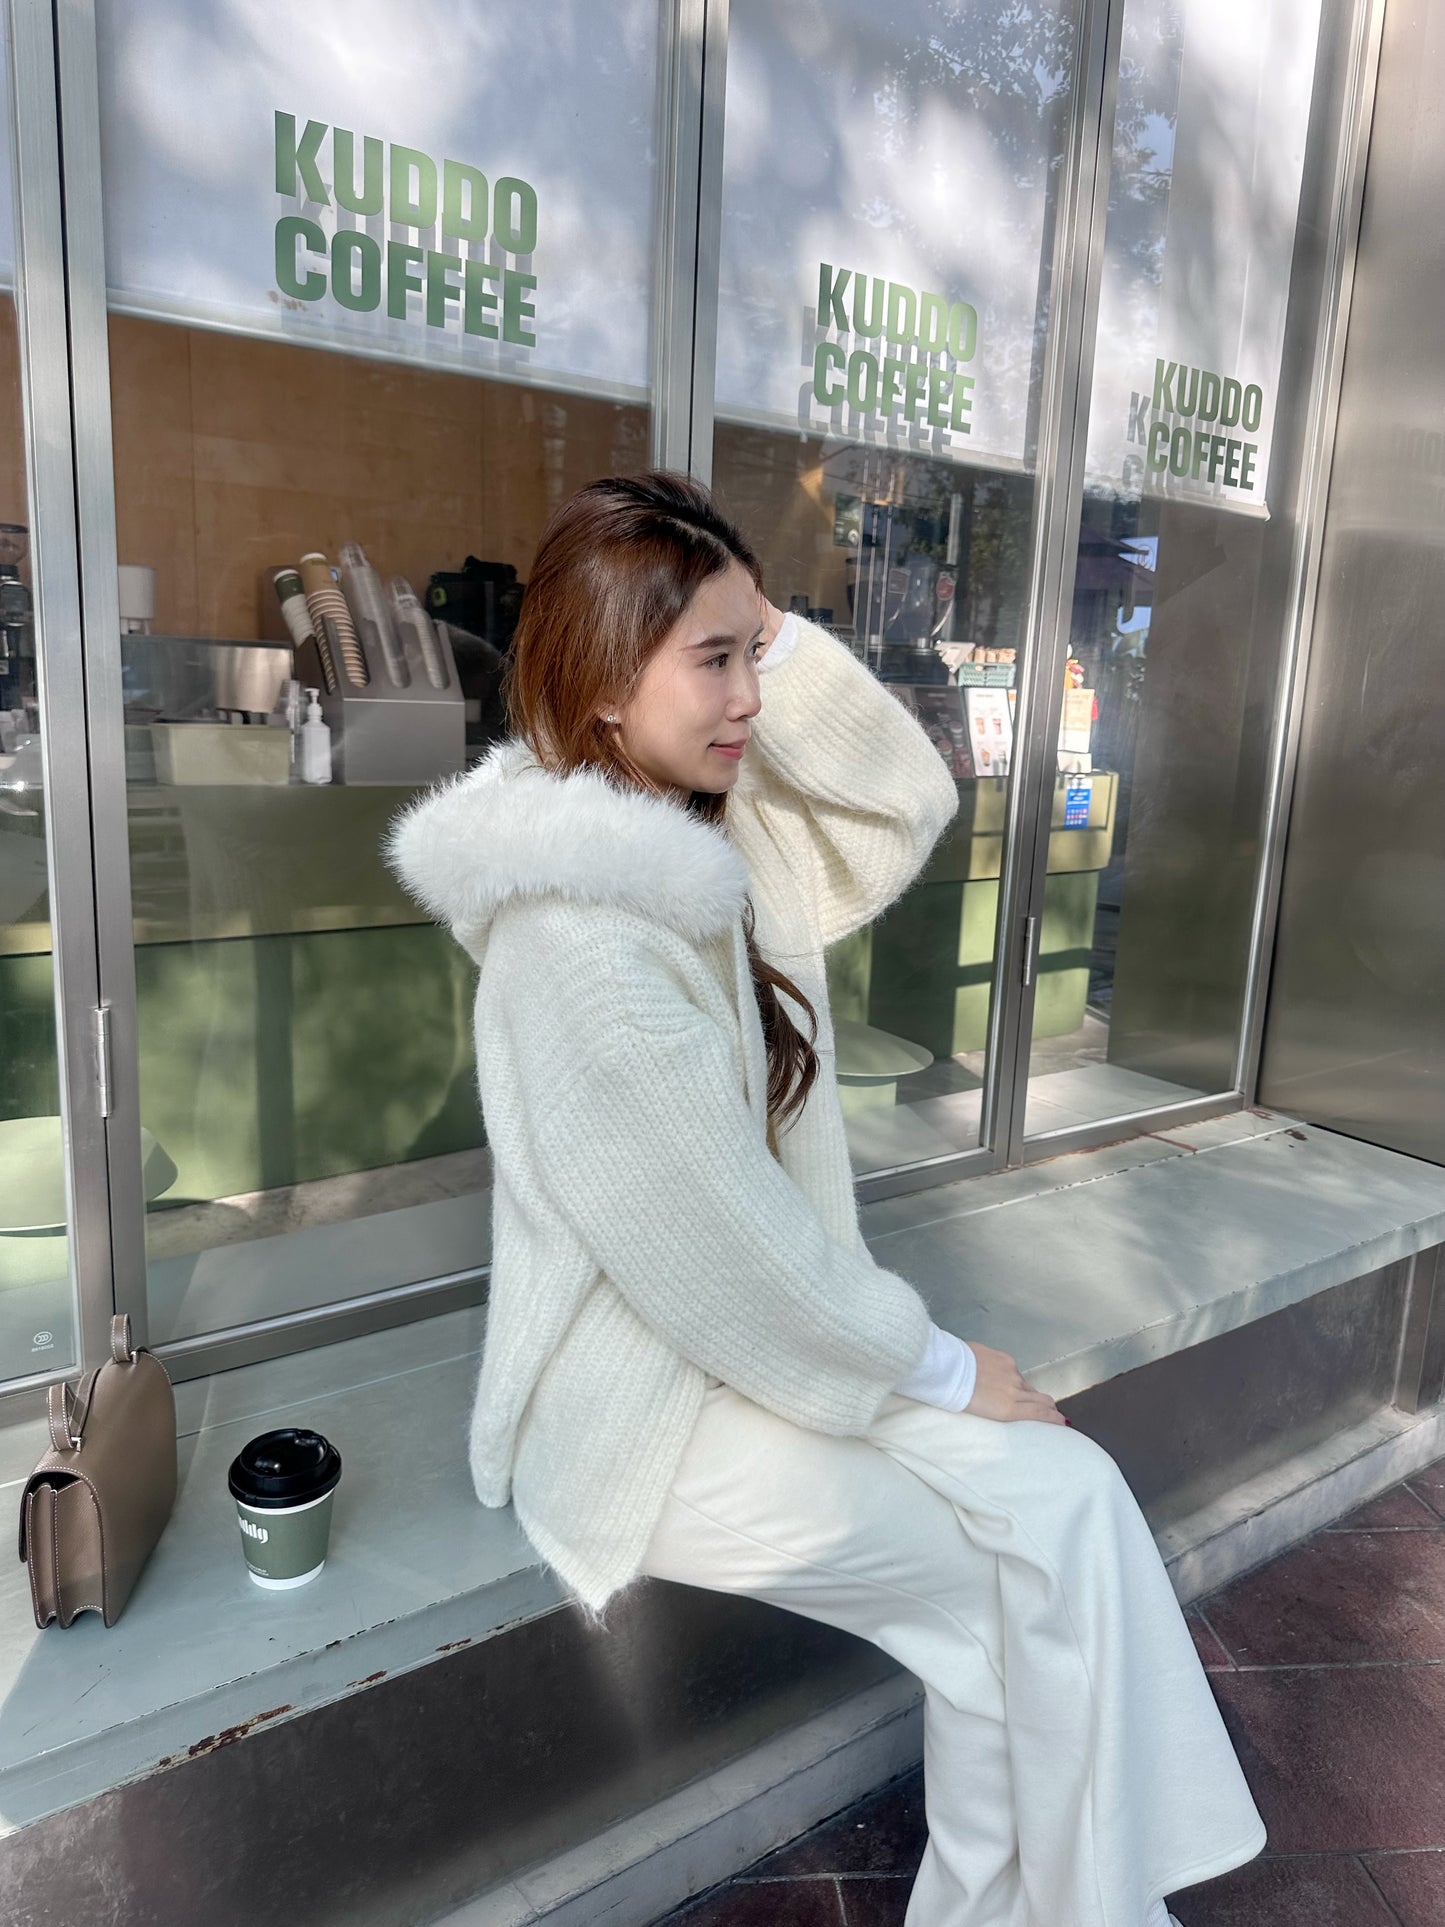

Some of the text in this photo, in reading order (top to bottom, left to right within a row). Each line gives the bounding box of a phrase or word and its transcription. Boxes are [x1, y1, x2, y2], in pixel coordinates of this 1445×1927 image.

[275, 110, 537, 255] KUDDO
[275, 216, 537, 348] COFFEE
[818, 262, 978, 363] KUDDO
[814, 342, 976, 435] COFFEE
[1152, 358, 1263, 433] KUDDO
[1147, 421, 1258, 491] COFFEE
